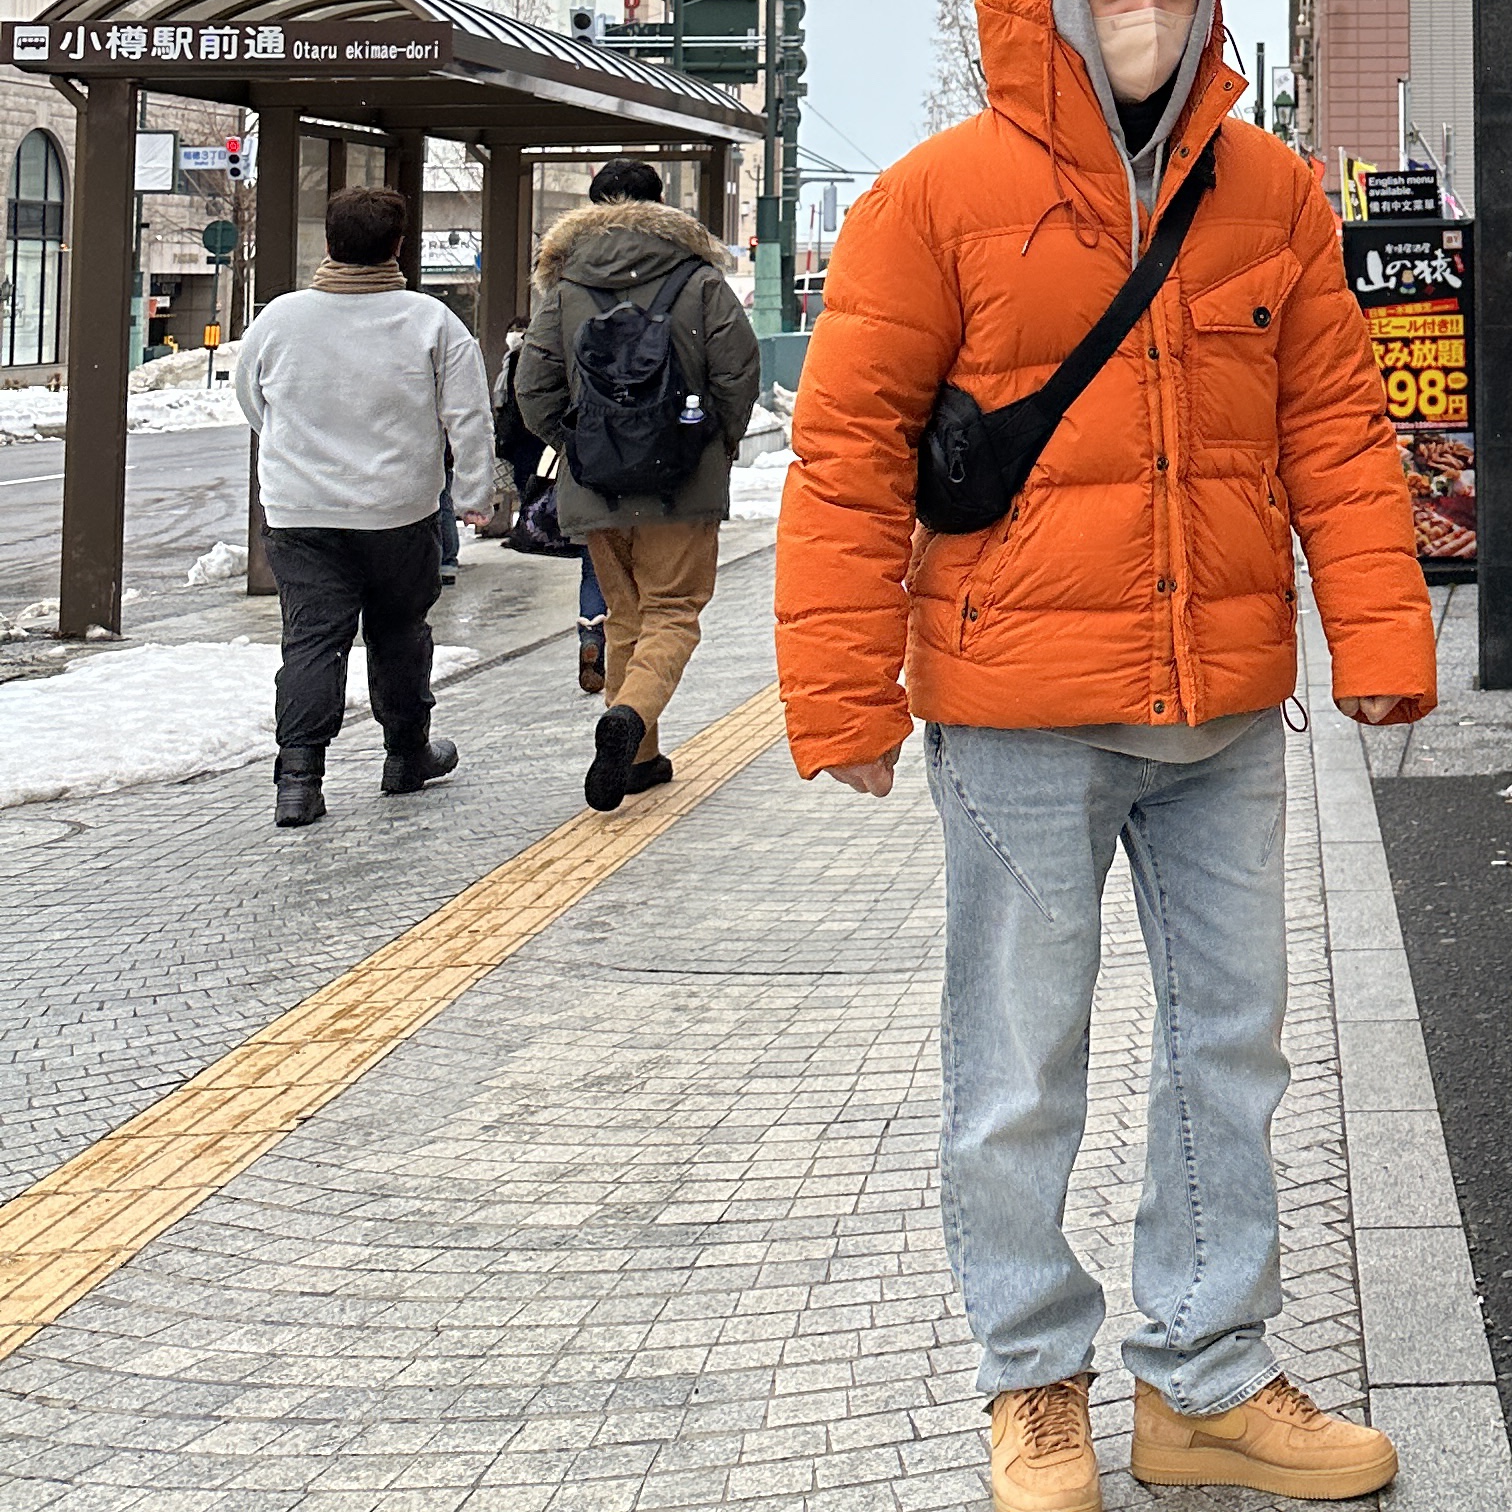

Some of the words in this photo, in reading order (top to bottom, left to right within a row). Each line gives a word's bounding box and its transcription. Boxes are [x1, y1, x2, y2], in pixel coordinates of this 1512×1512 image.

[59, 25, 286, 61] 小樽駅前通
[293, 40, 338, 61] Otaru
[345, 40, 439, 60] ekimae-dori
[1368, 176, 1405, 187] English
[1406, 176, 1435, 185] menu
[1368, 186, 1414, 197] available.
